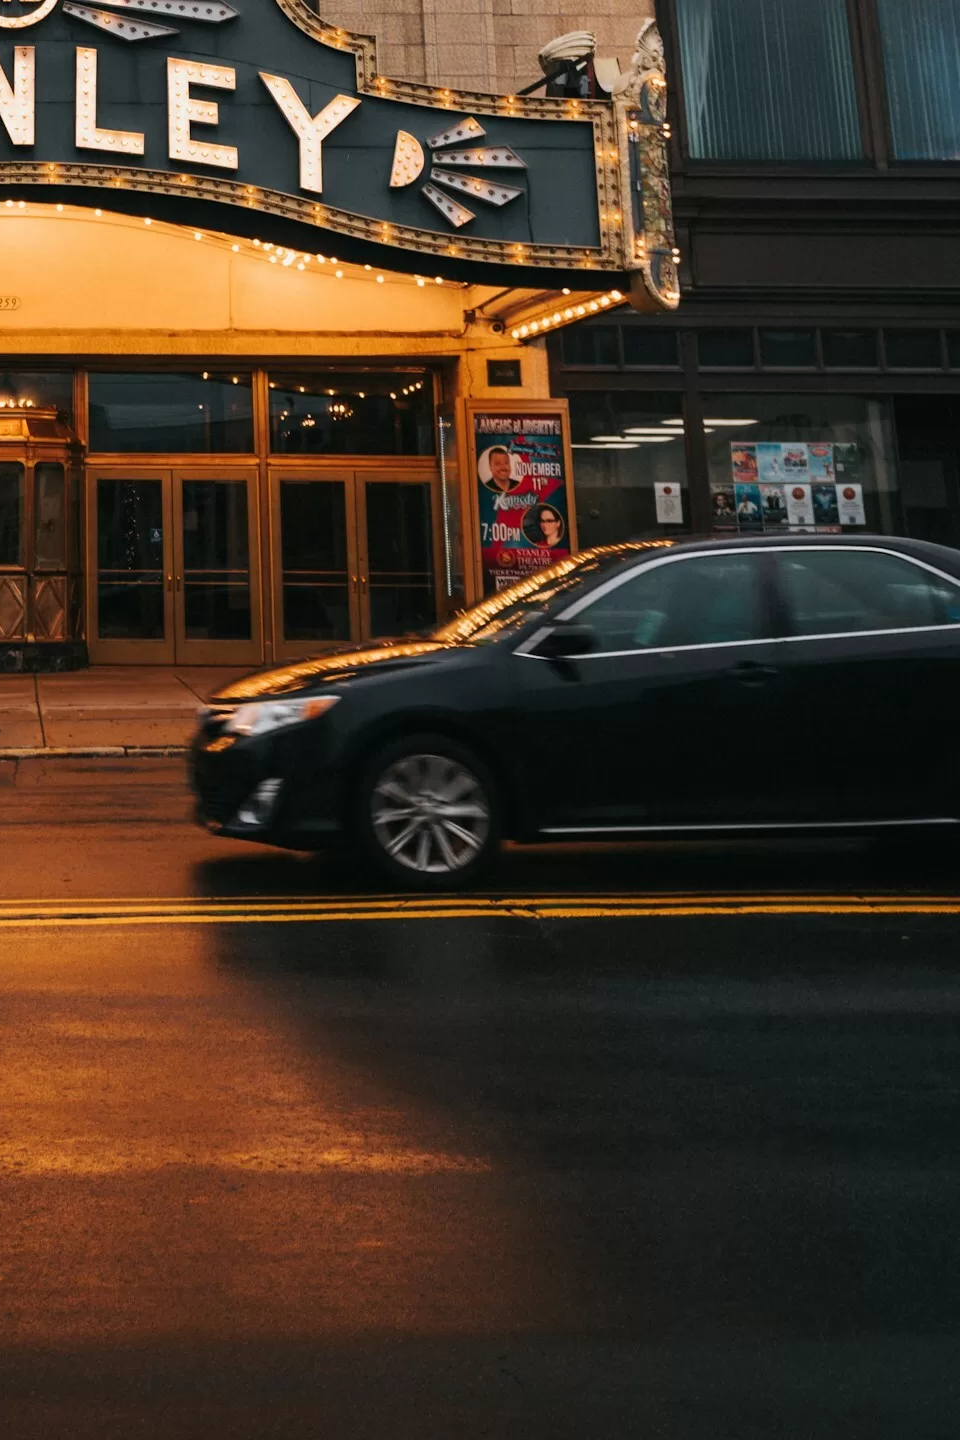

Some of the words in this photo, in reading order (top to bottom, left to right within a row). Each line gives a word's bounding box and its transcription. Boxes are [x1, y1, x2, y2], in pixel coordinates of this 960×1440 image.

[515, 462, 561, 476] NOVEMBER
[481, 523, 520, 541] 7:00PM
[516, 548, 551, 557] STANLEY
[517, 557, 553, 565] THEATRE
